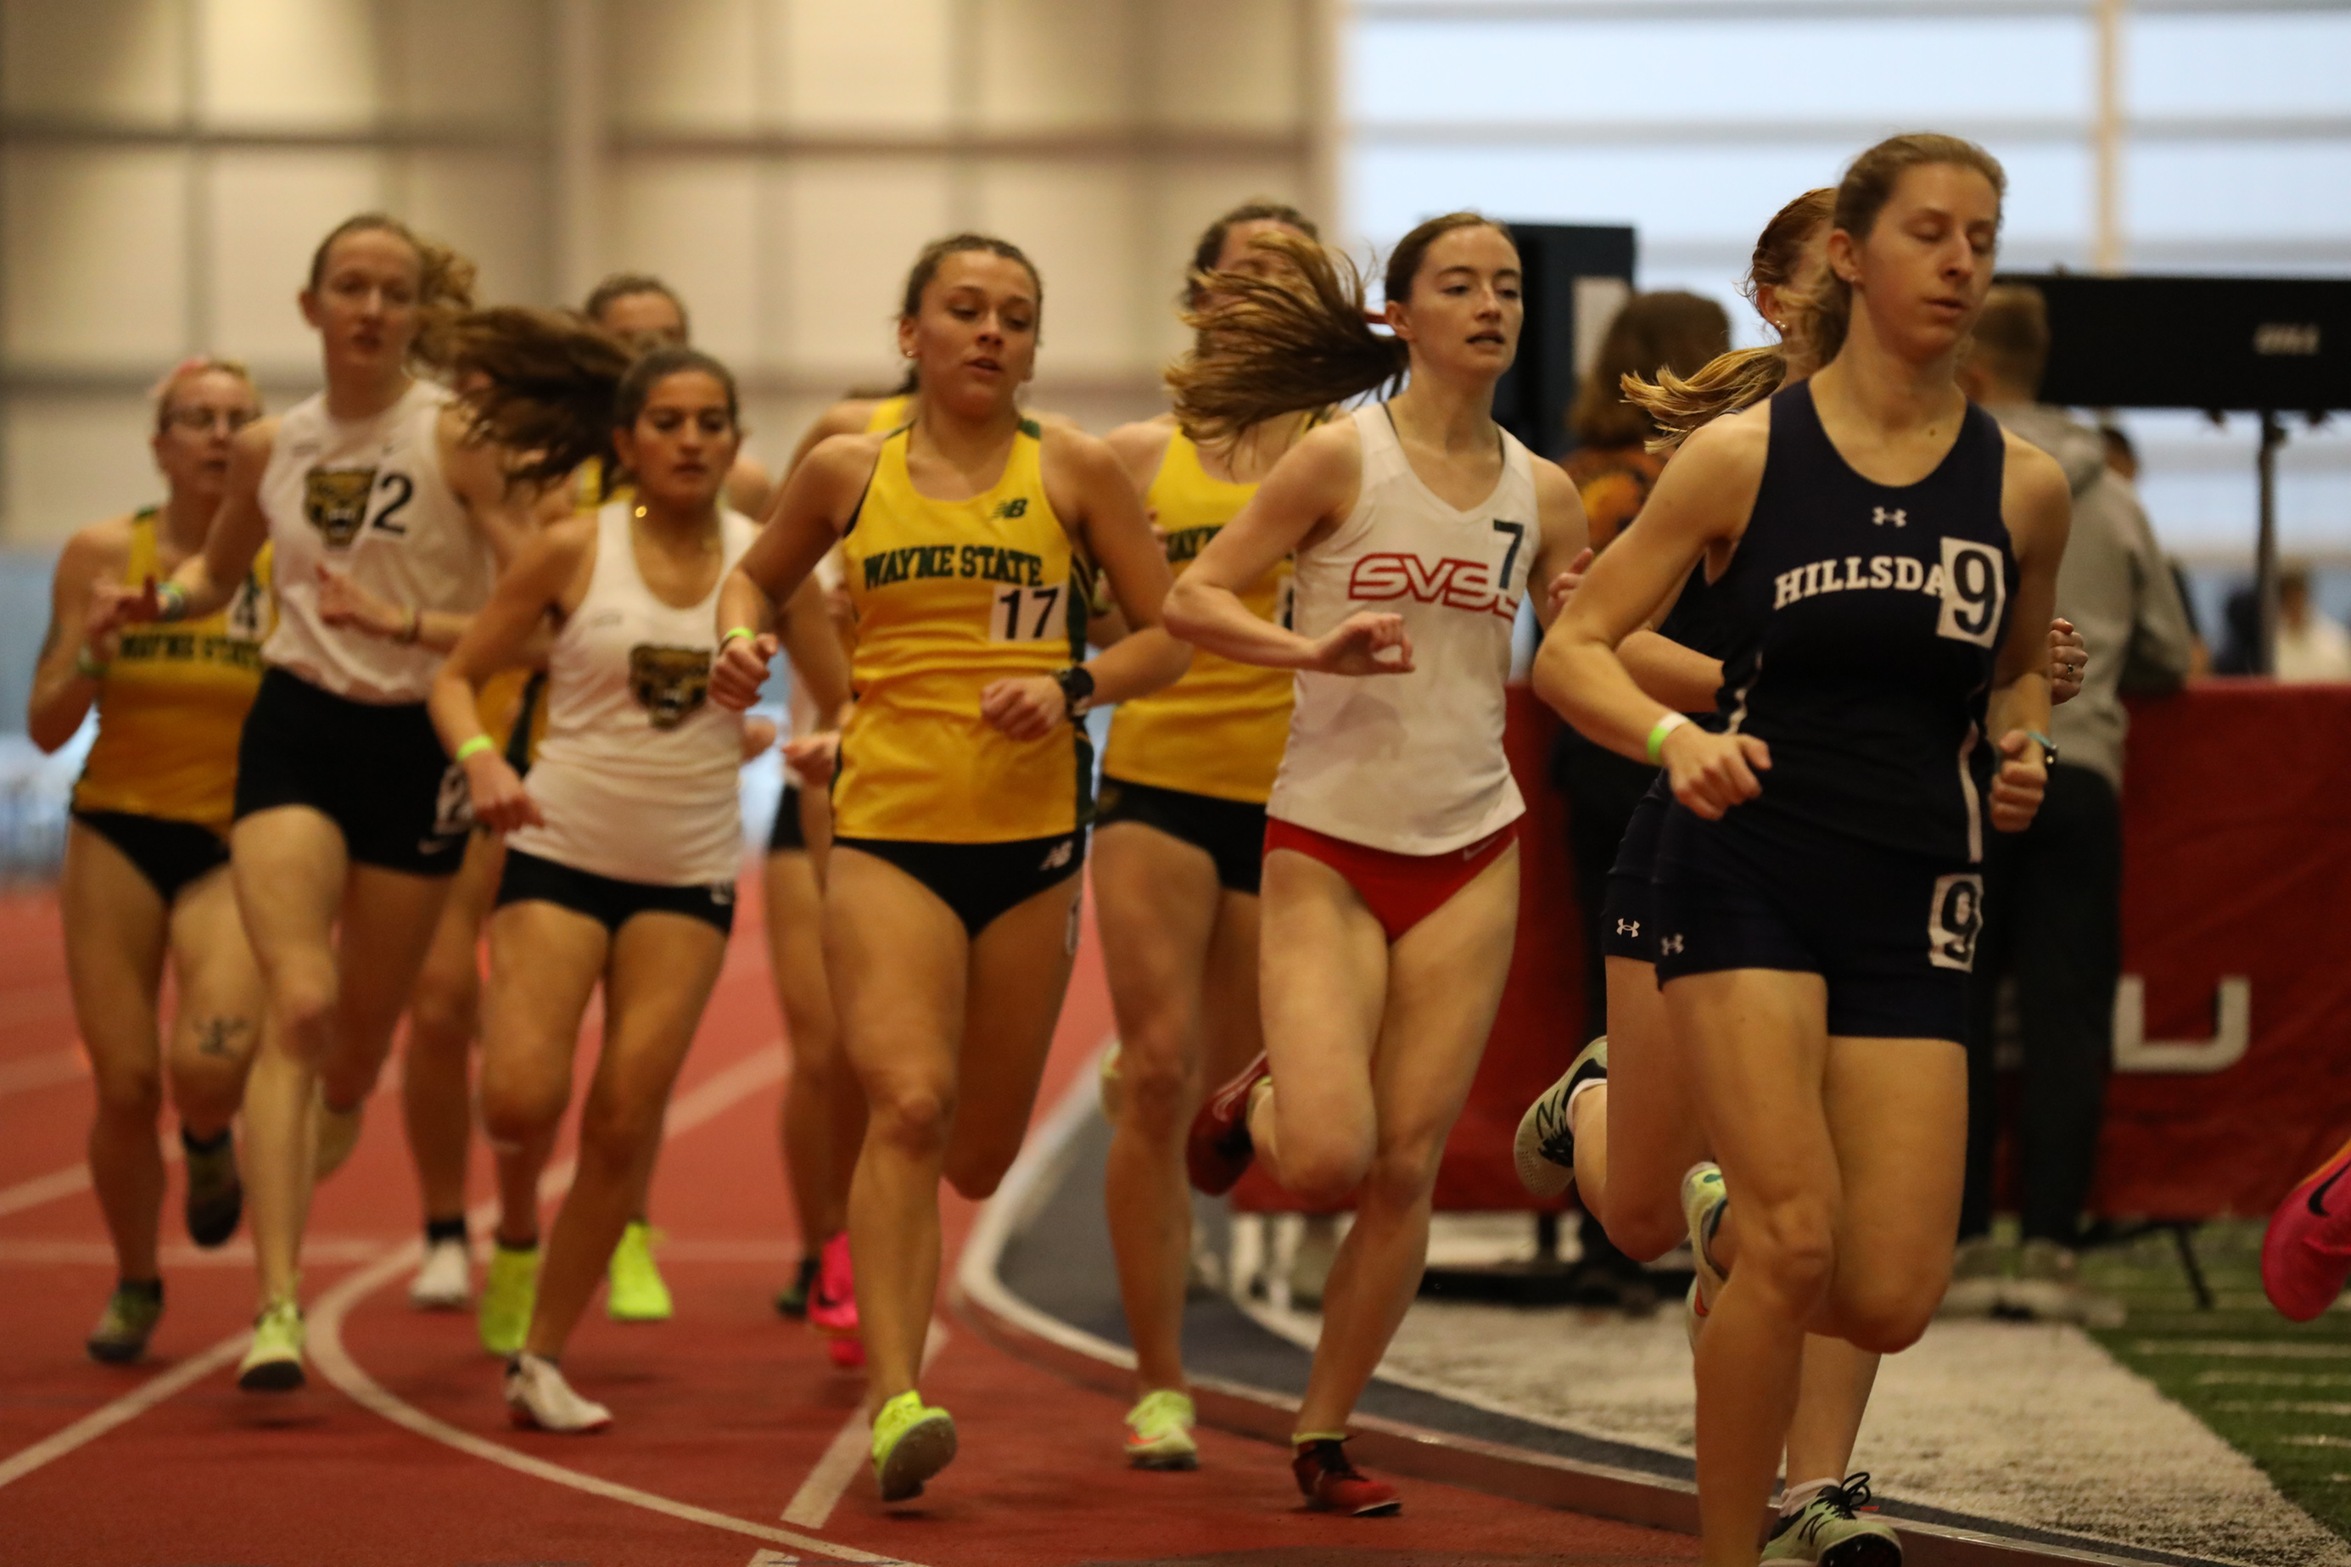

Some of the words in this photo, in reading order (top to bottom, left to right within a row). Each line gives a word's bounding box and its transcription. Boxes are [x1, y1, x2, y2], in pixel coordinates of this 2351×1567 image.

[373, 471, 413, 535] 2
[864, 545, 954, 591] WAYNE
[960, 545, 1043, 586] STATE
[1493, 518, 1525, 590] 7
[1773, 555, 1946, 611] HILLSDA
[999, 587, 1059, 640] 17
[1953, 548, 1996, 636] 9
[1941, 880, 1978, 963] 9
